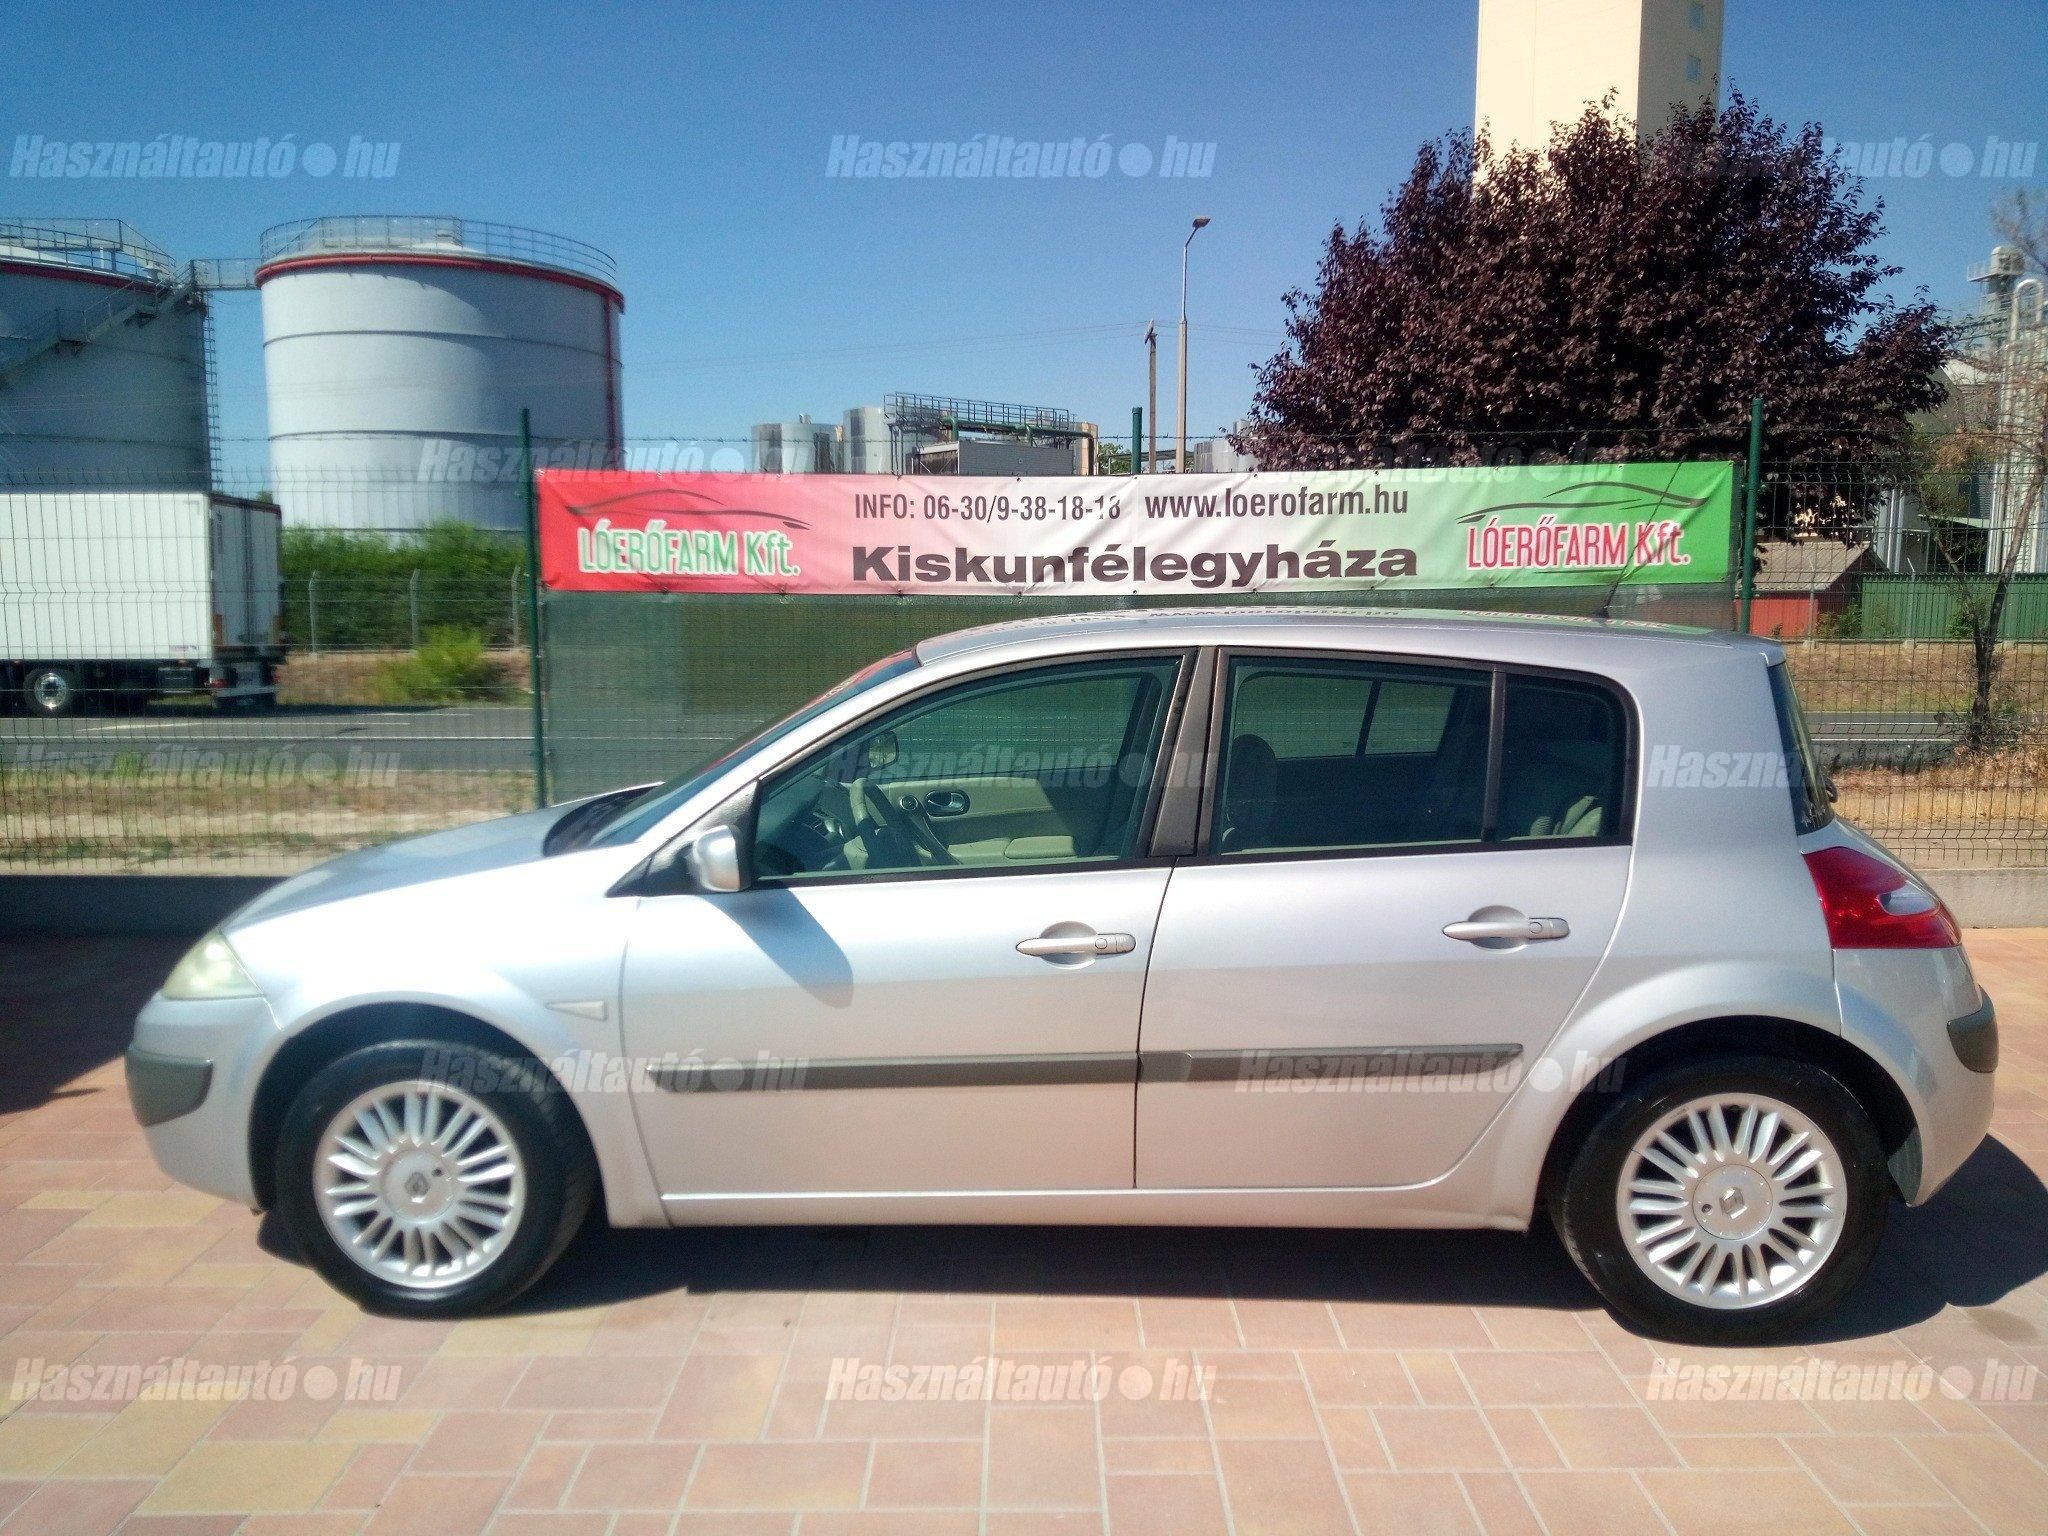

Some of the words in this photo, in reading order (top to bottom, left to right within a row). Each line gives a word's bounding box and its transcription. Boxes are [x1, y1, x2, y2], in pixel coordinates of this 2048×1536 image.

[854, 493, 915, 519] INFO:
[1144, 486, 1409, 519] www.loerofarm.hu
[743, 530, 801, 576] Kft.
[852, 539, 1418, 588] Kiskunfélegyháza
[1467, 514, 1628, 569] LÓERŐFARM
[1635, 519, 1691, 566] Kft.
